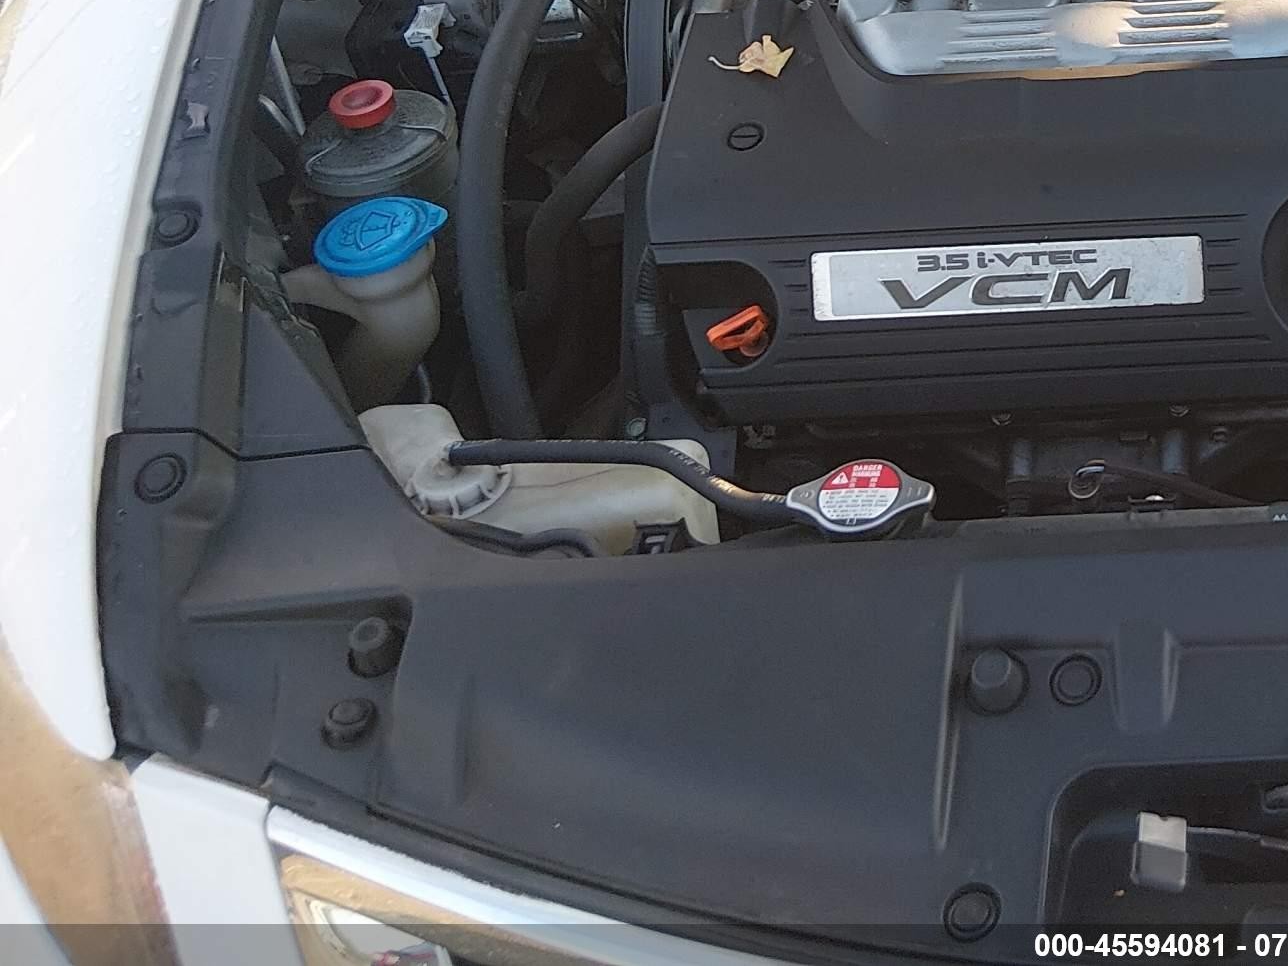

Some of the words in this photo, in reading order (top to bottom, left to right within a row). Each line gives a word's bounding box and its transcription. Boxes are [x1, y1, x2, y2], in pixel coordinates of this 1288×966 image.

[917, 253, 970, 273] 3.5
[976, 249, 1098, 270] i-VTEC
[878, 267, 1133, 311] VCM
